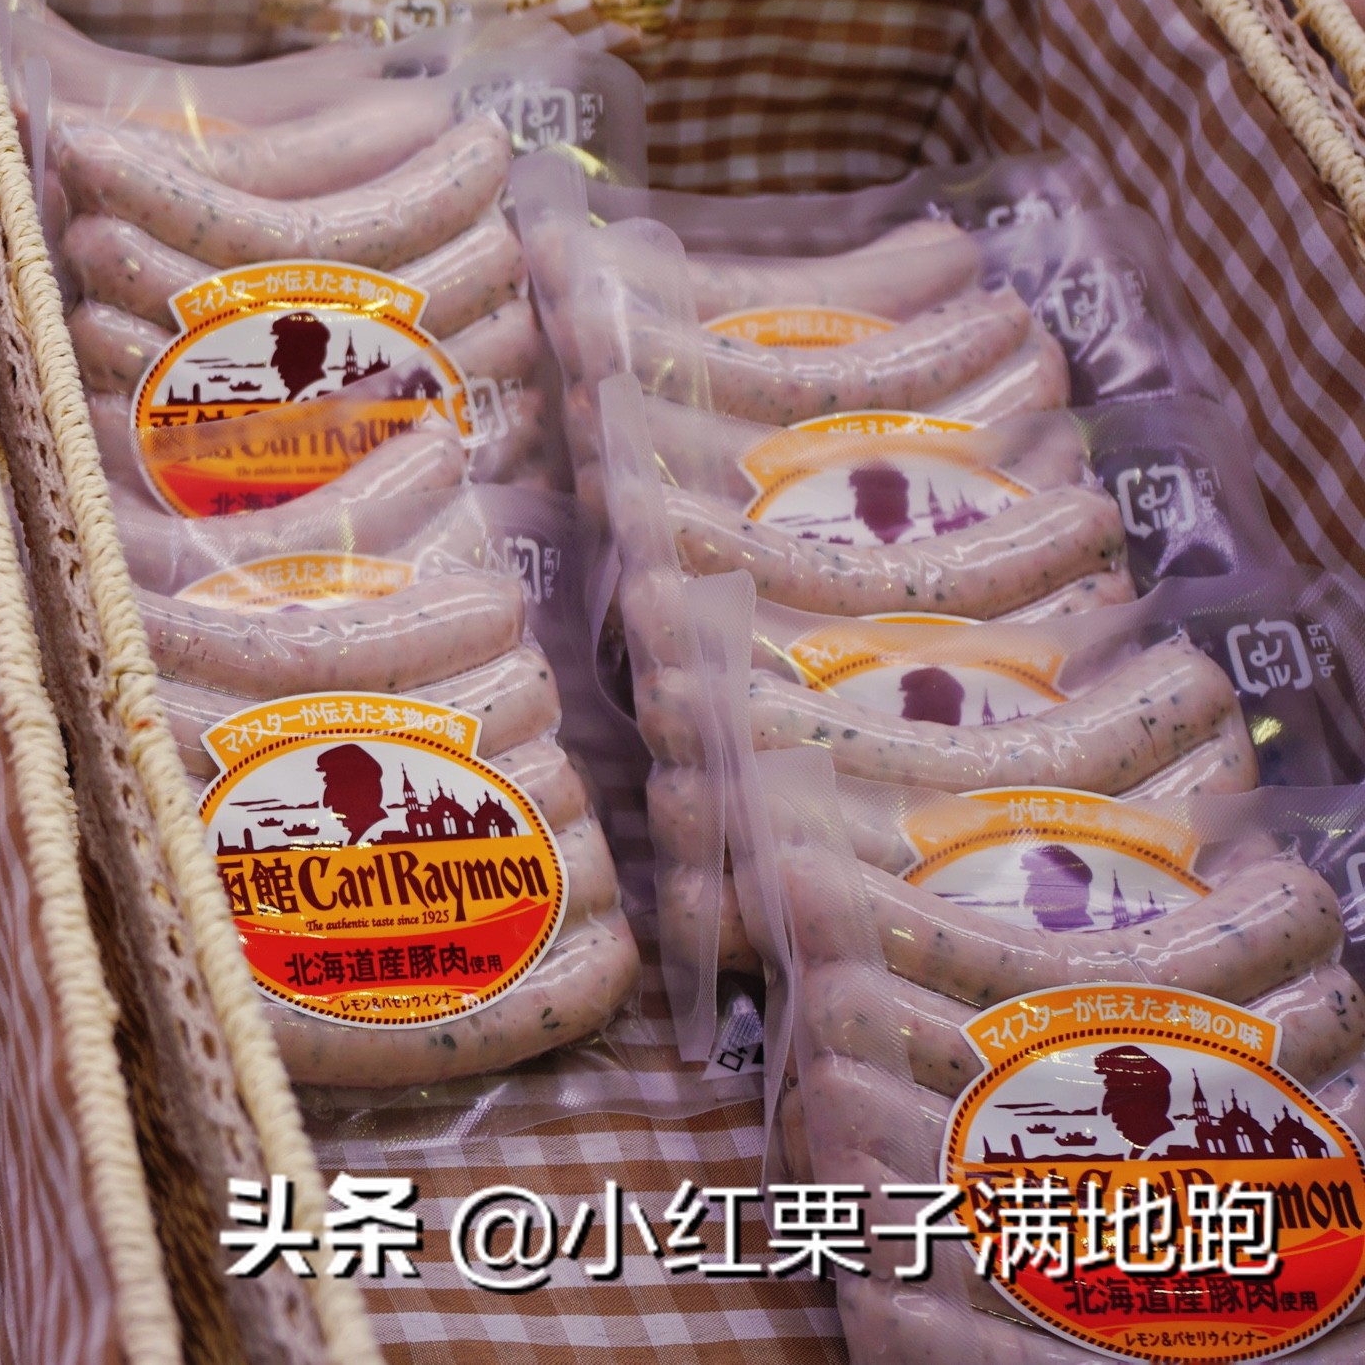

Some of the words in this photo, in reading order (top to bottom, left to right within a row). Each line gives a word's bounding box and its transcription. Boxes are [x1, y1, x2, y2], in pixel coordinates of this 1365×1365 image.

[219, 701, 467, 753] マイスターが伝えた本物の味
[306, 919, 323, 932] The
[325, 918, 370, 931] authentic
[372, 917, 395, 928] taste
[397, 915, 420, 926] since
[422, 910, 450, 925] 1925
[285, 942, 504, 987] 北海道産豚肉使用
[980, 993, 1265, 1051] マイスターが伝えた本物の味
